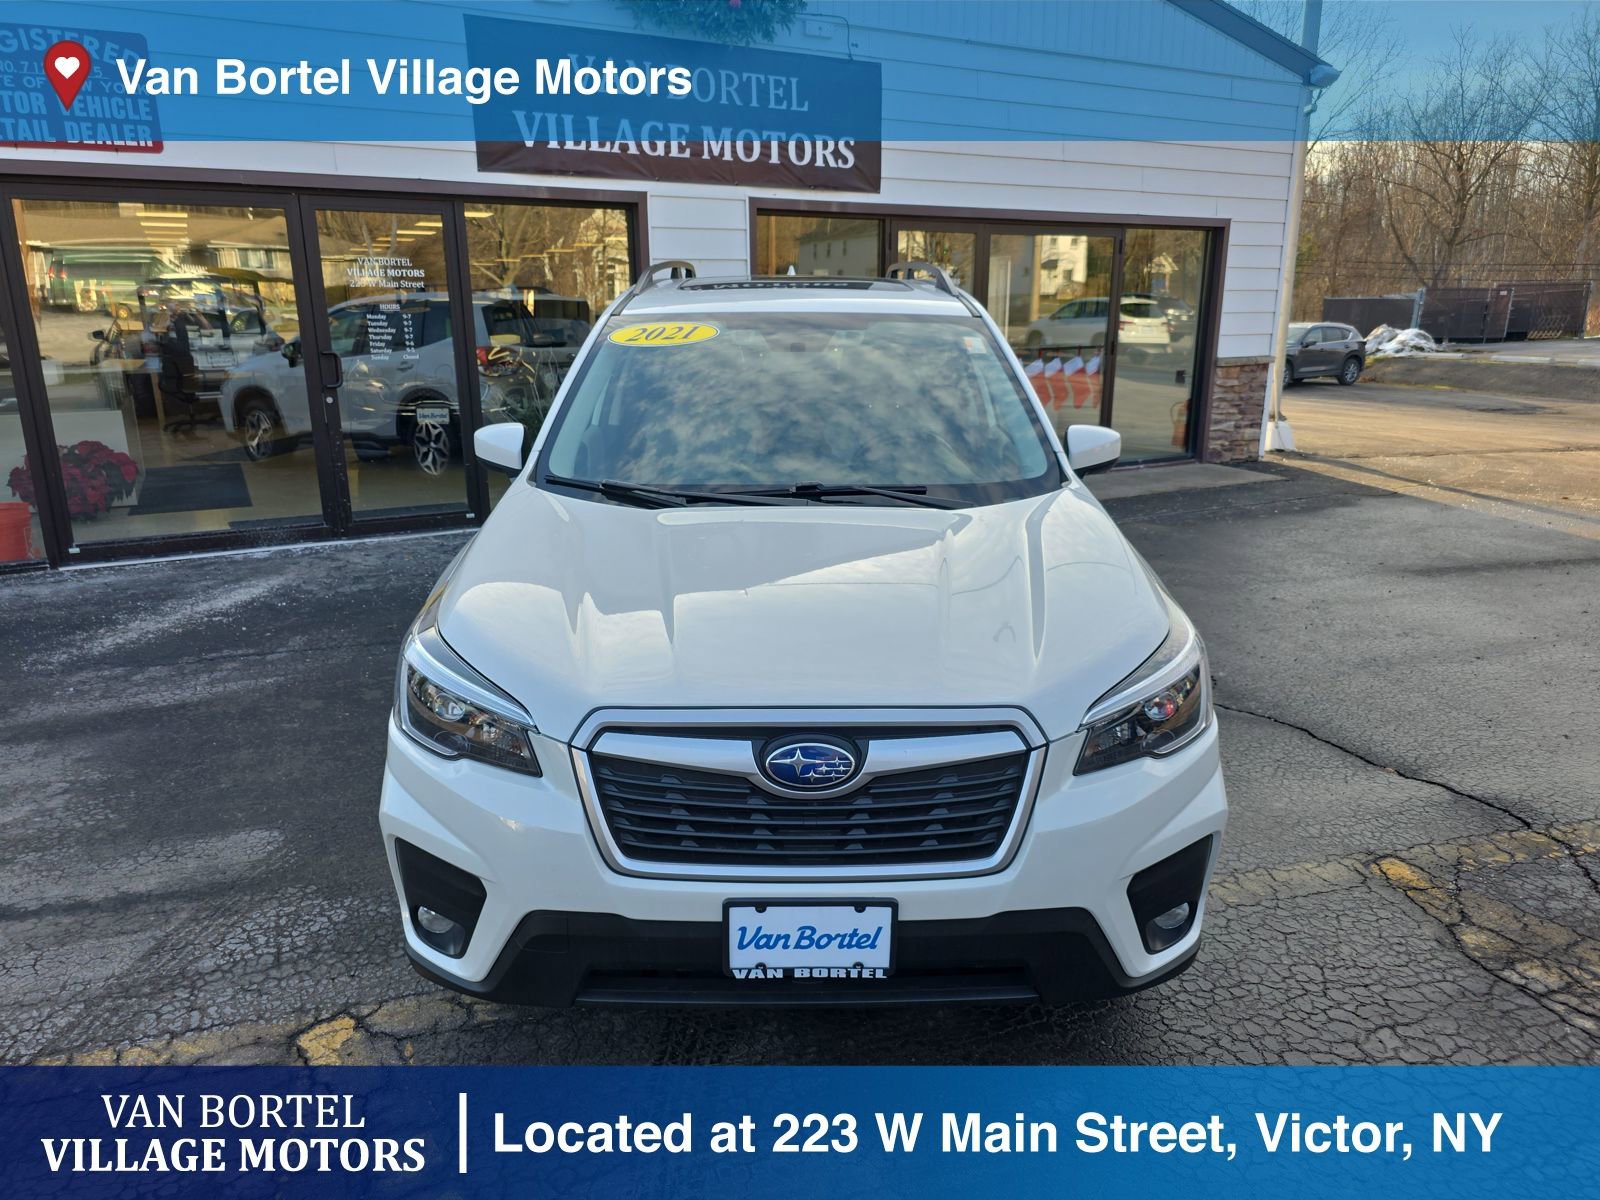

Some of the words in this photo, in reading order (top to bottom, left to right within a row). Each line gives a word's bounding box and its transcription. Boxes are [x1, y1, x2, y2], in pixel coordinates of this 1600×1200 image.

[567, 53, 652, 98] VN
[23, 76, 45, 88] OF
[100, 80, 147, 95] YOK
[0, 118, 56, 143] TAIL
[64, 121, 153, 147] DEALER
[512, 110, 691, 158] VILLAGE
[701, 126, 856, 169] MOTORS
[357, 257, 377, 266] VAN
[378, 257, 412, 267] BORTEL
[346, 268, 385, 277] VILLAGE
[386, 269, 425, 278] MOTORS
[378, 280, 399, 288] Main
[400, 280, 425, 288] Street
[625, 326, 700, 342] 2021
[737, 925, 791, 951] Van
[793, 925, 883, 950] Bortel
[732, 968, 784, 979] VAN
[794, 968, 887, 979] BORTEL
